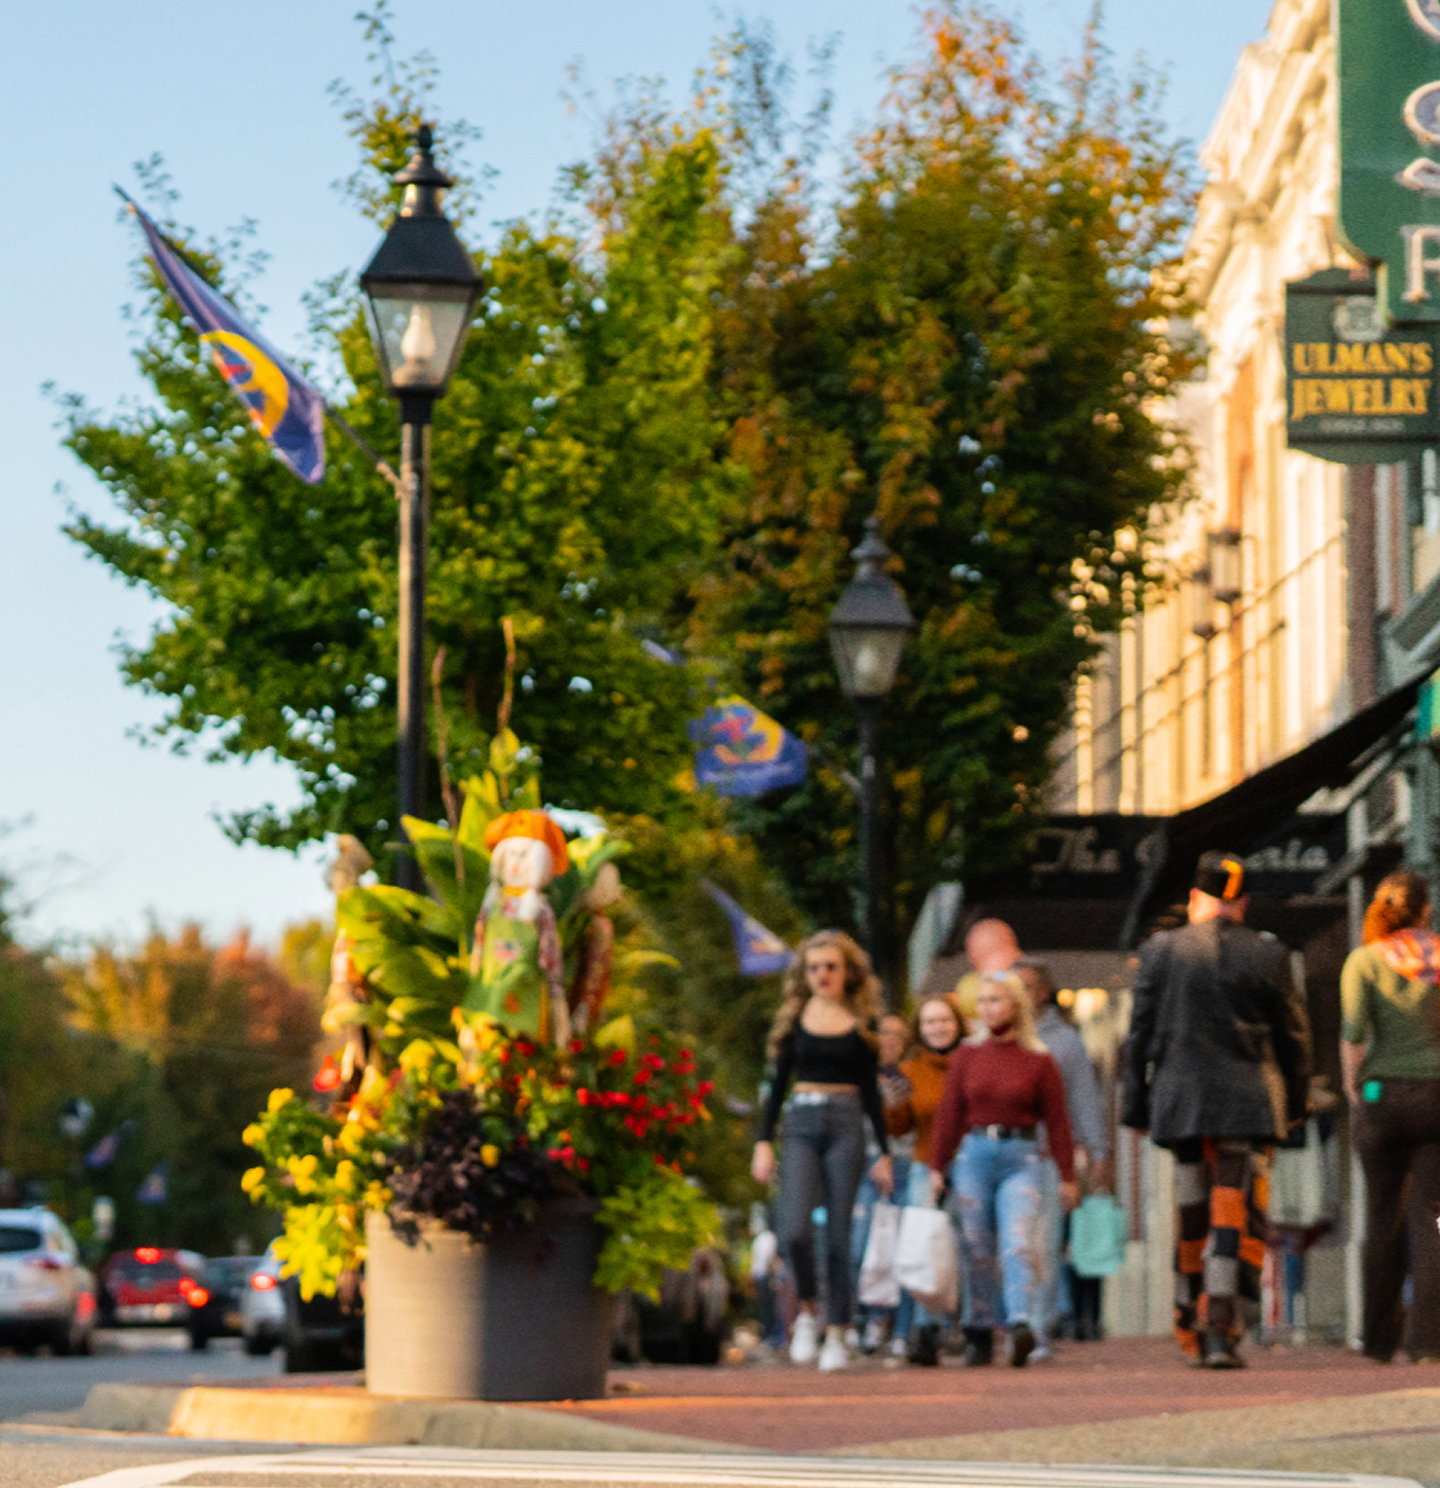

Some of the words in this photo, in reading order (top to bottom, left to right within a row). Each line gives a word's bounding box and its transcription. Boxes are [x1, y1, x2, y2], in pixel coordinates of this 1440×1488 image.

[1293, 342, 1433, 374] ULMAN'S
[1291, 378, 1432, 421] JEWELRY
[1032, 826, 1119, 873] The
